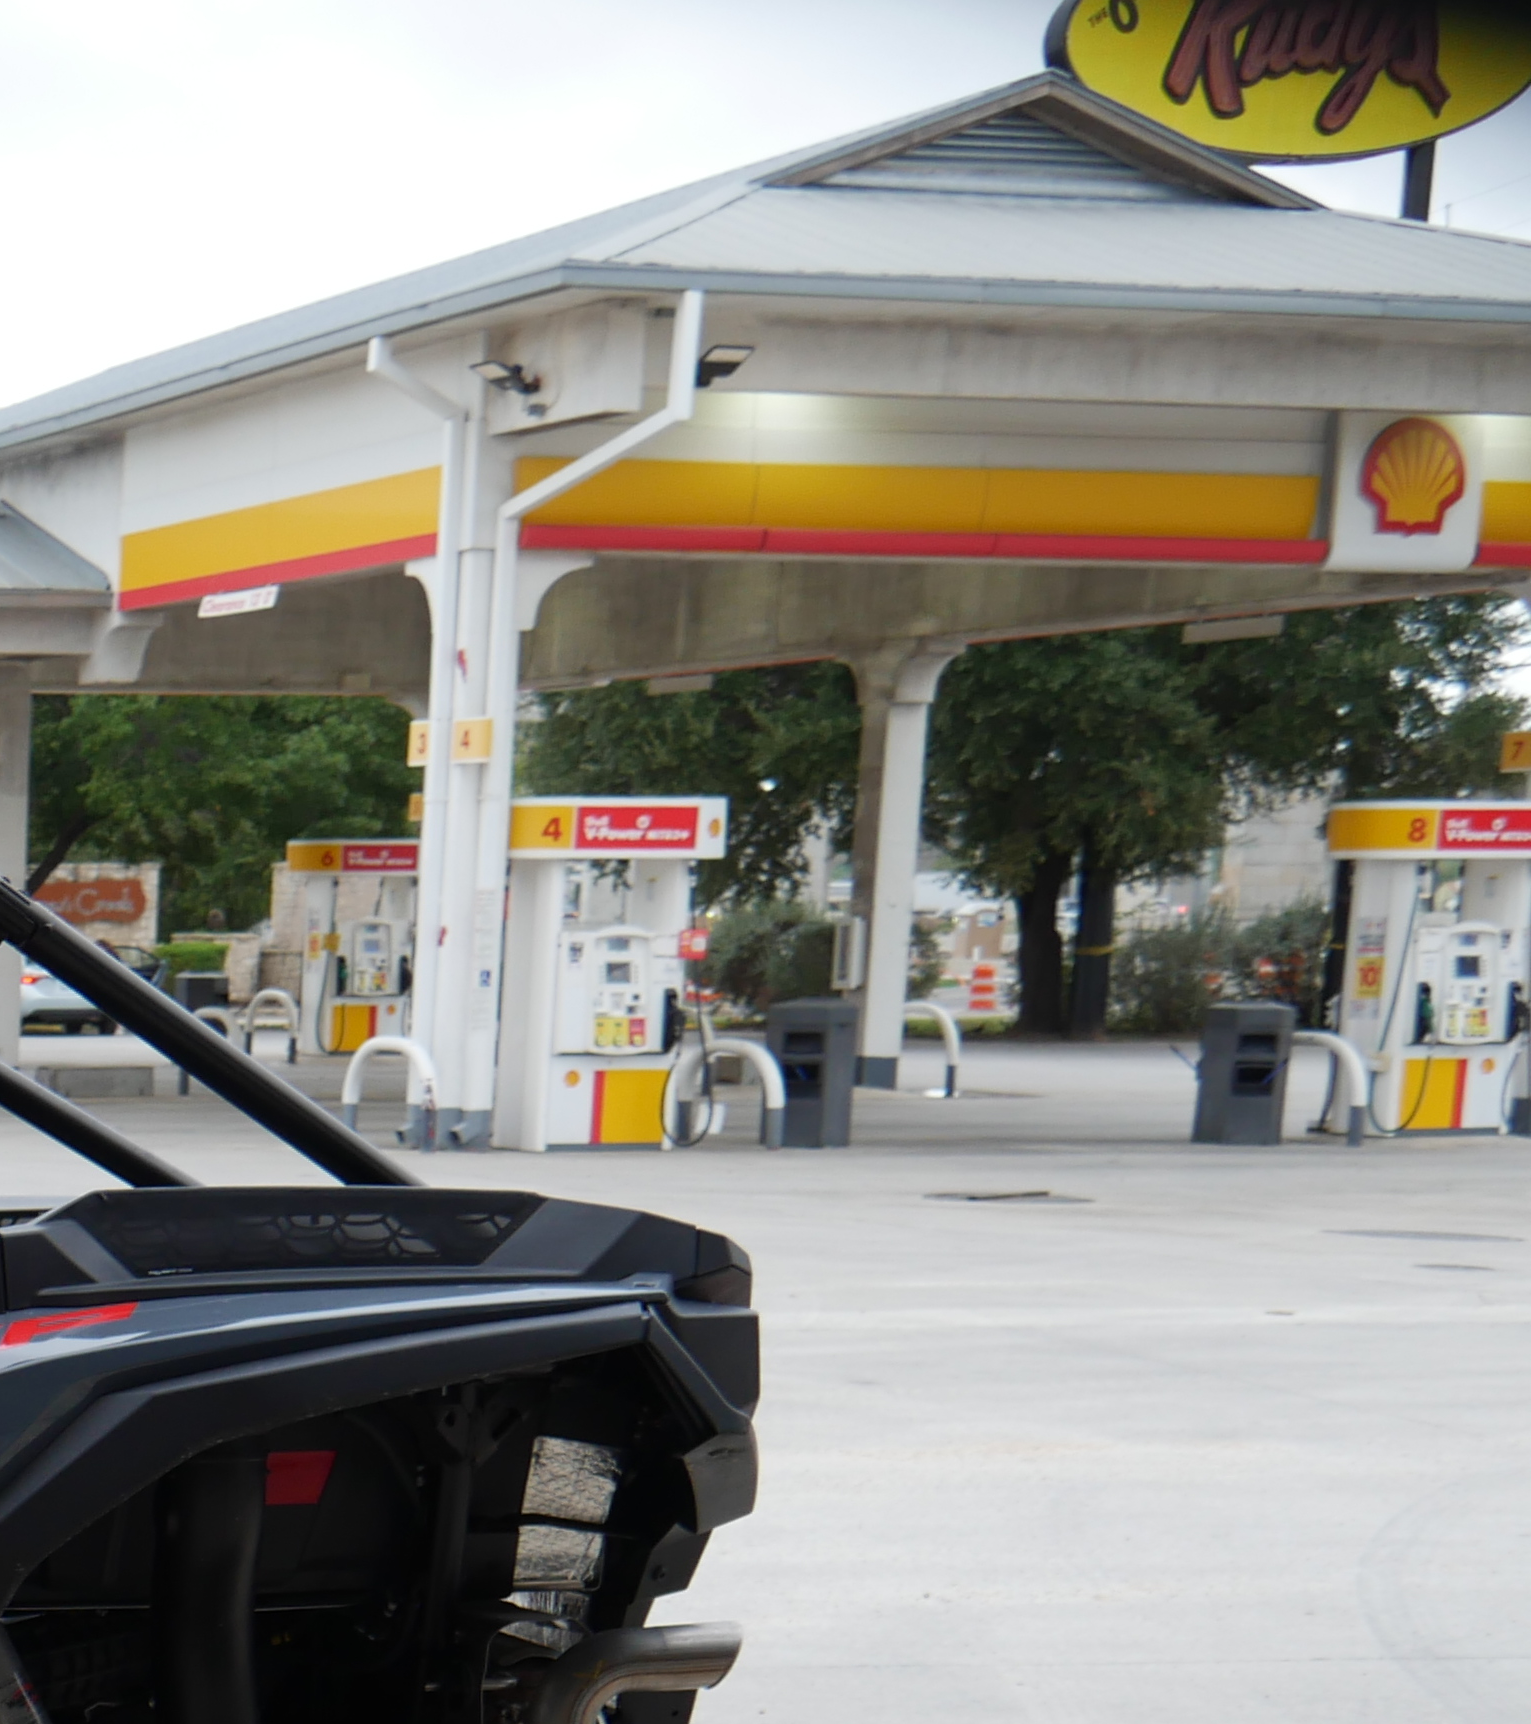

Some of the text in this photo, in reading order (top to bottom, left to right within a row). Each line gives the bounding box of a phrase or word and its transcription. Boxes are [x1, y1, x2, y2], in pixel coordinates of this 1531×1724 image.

[459, 728, 471, 750] 4
[1512, 741, 1524, 761] 7
[541, 816, 562, 842] 4
[1407, 816, 1427, 843] 8
[321, 850, 335, 867] 6
